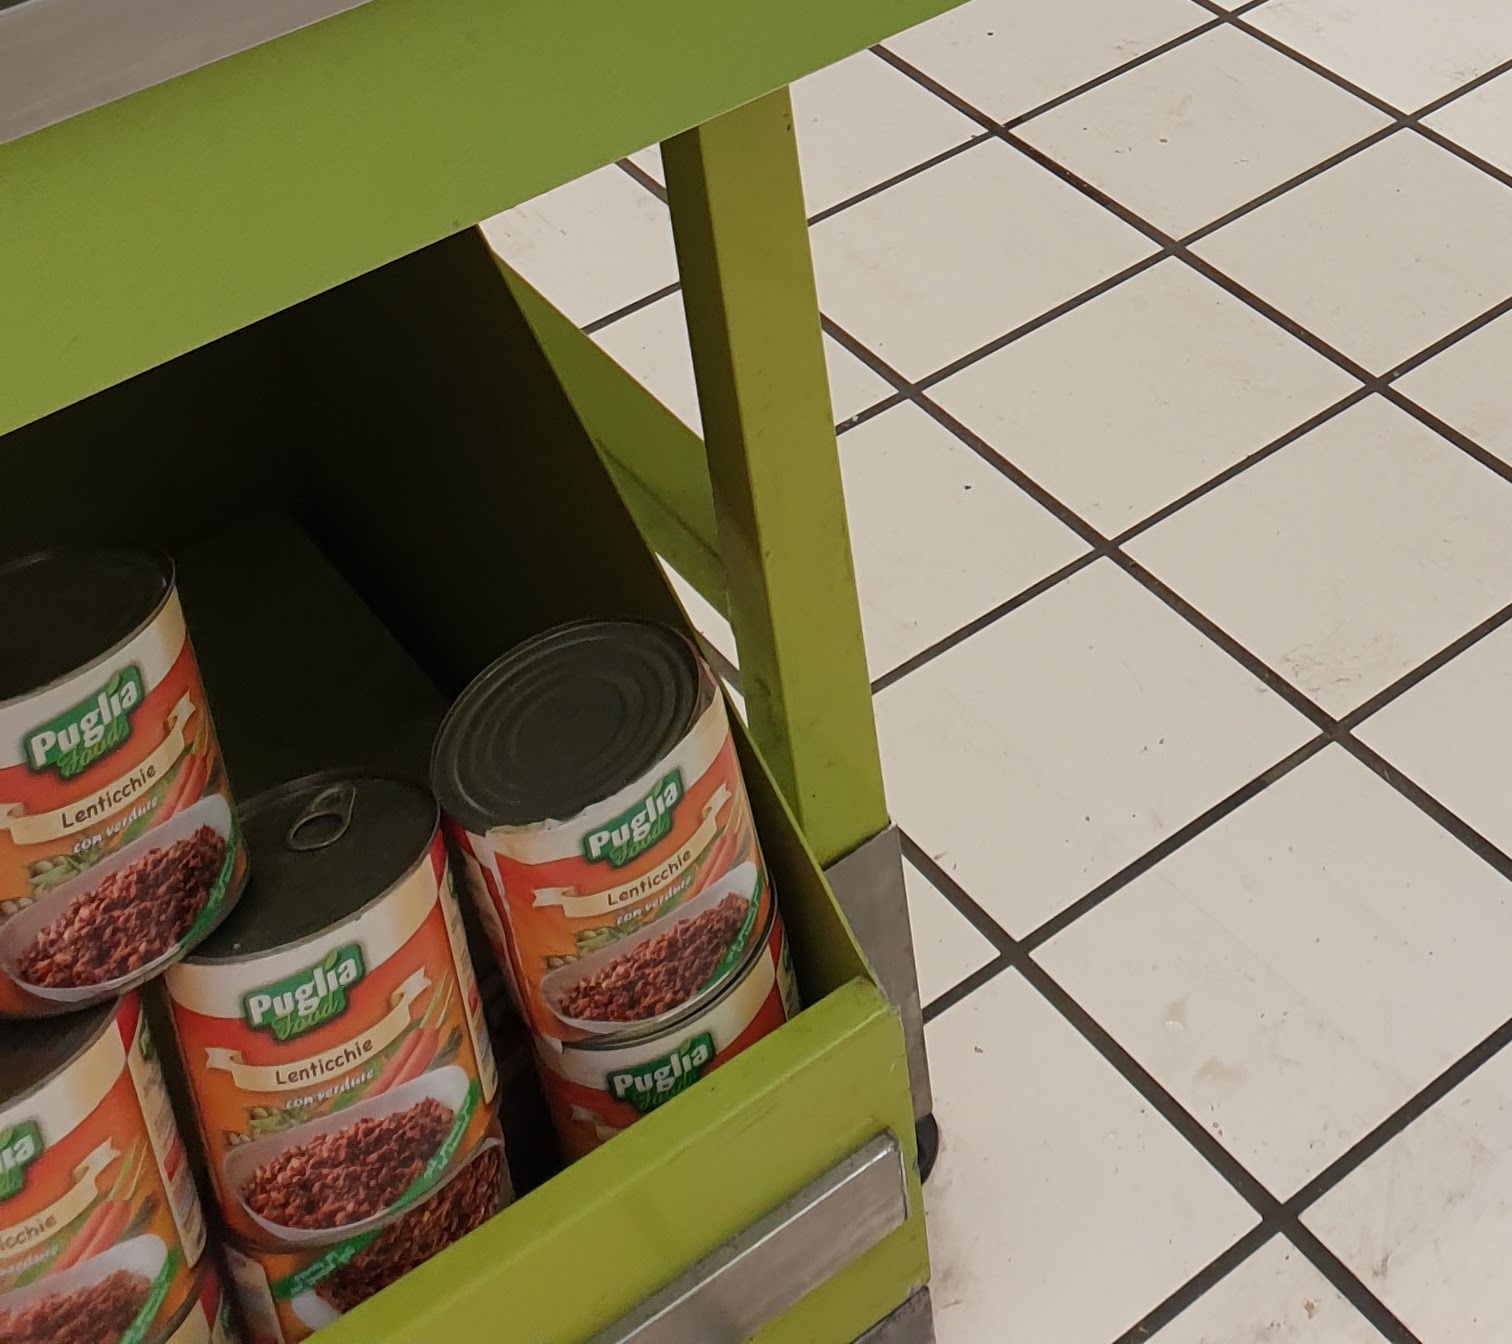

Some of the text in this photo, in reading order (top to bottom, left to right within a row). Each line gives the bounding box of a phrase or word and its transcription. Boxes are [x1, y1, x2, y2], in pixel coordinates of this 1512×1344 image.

[31, 680, 138, 767] Puglia
[61, 764, 158, 829] Lenticchie
[73, 796, 159, 854] con verdure
[588, 781, 679, 858] Puglia
[607, 849, 692, 906] Lenticchie
[616, 874, 692, 926] con verdure
[249, 957, 359, 1024] Puglia
[275, 1037, 374, 1086] Lenticchie
[285, 1067, 375, 1110] con verdure
[613, 1043, 710, 1098] Puglia
